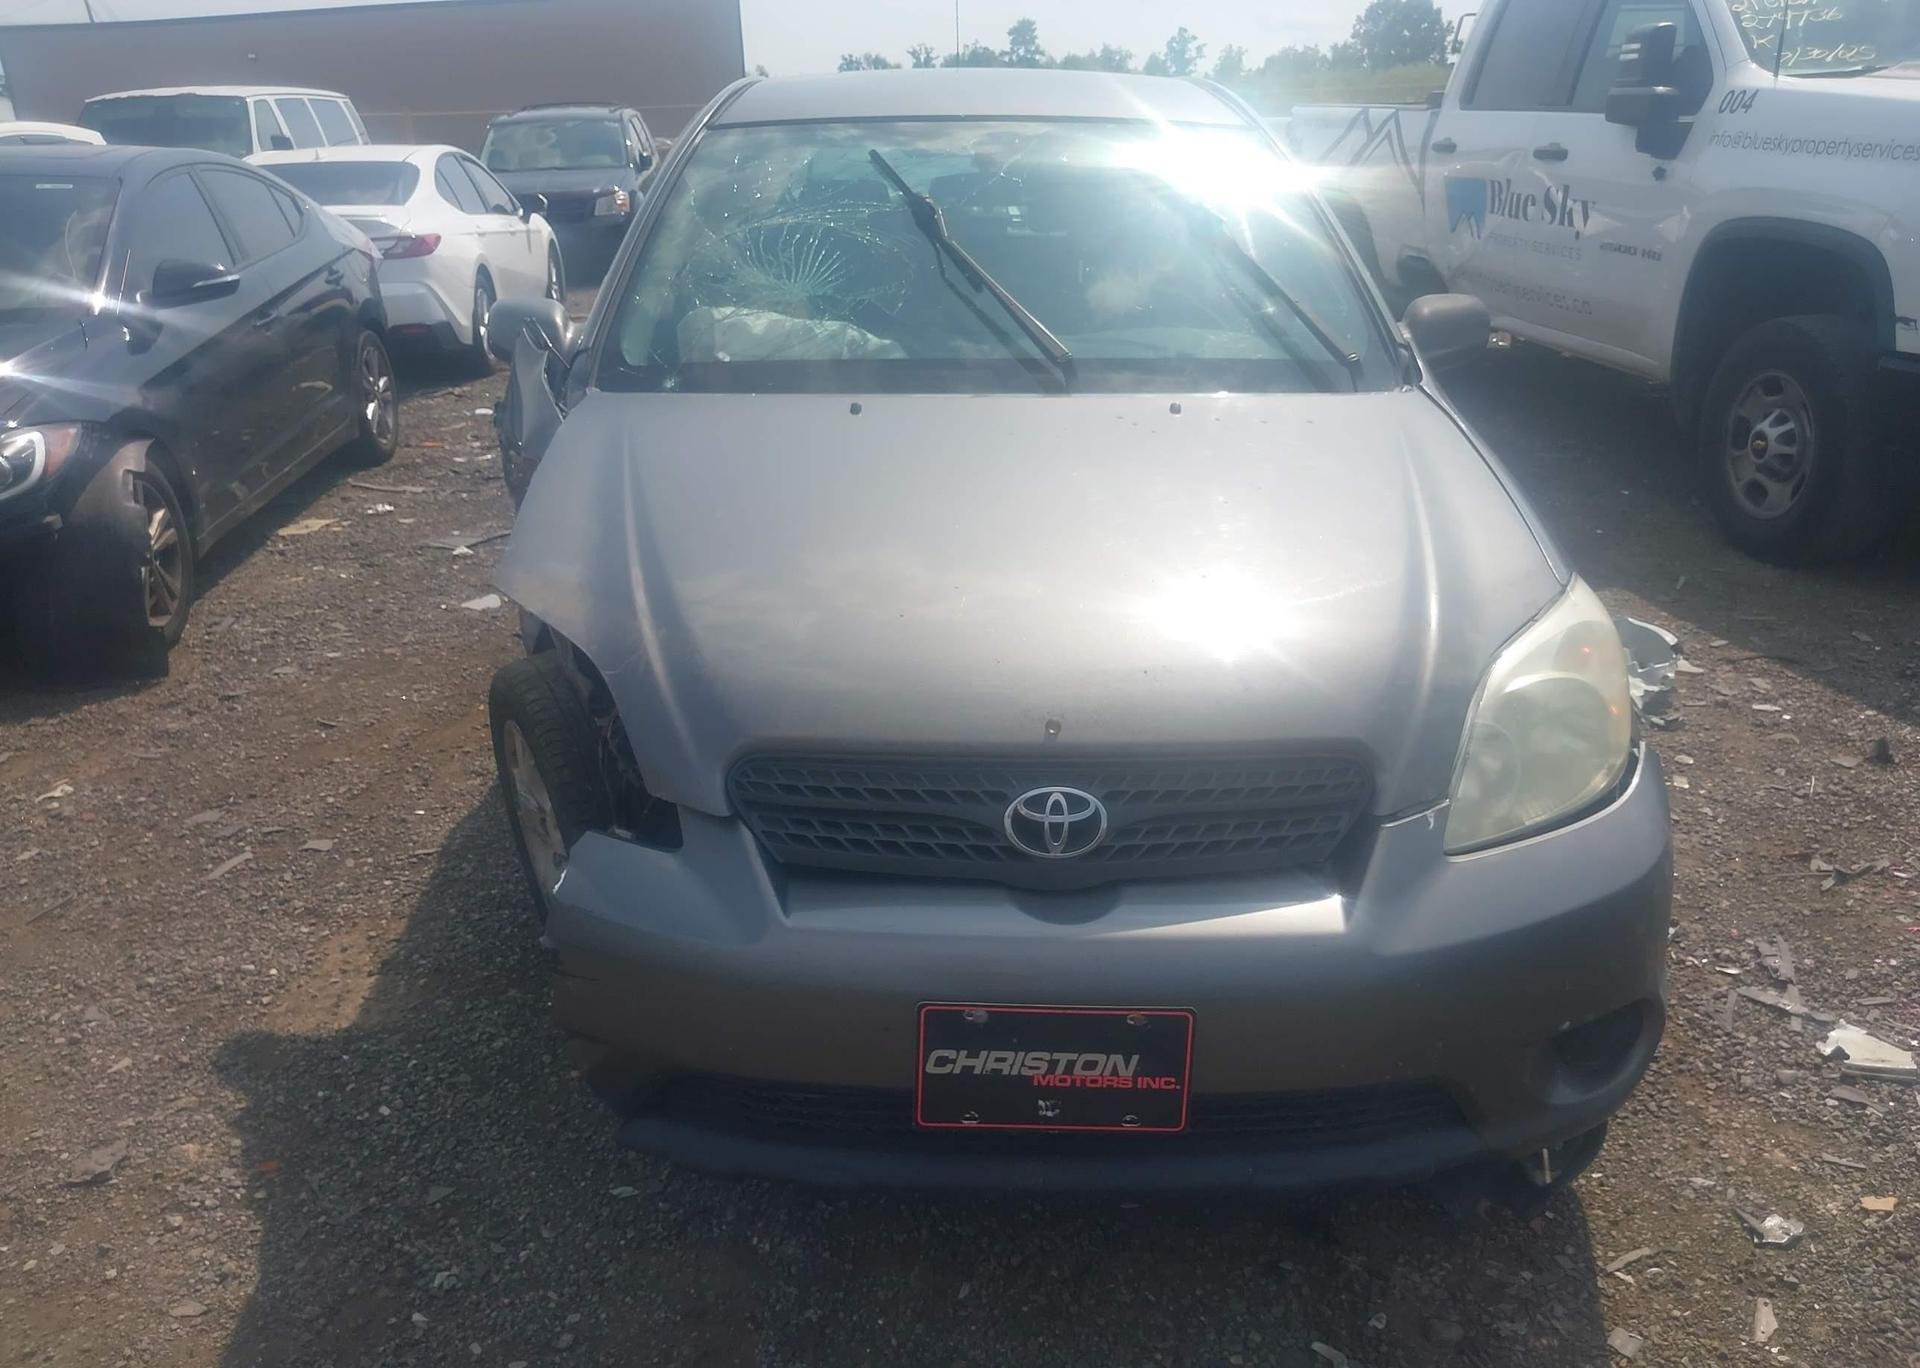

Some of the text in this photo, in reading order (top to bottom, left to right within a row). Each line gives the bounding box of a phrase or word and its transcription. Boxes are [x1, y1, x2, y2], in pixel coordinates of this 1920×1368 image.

[1718, 89, 1759, 114] 004
[1489, 178, 1596, 240] Blue Sky
[925, 1049, 1140, 1077] CHRISTON
[1033, 1074, 1181, 1090] MOTORS INC.
